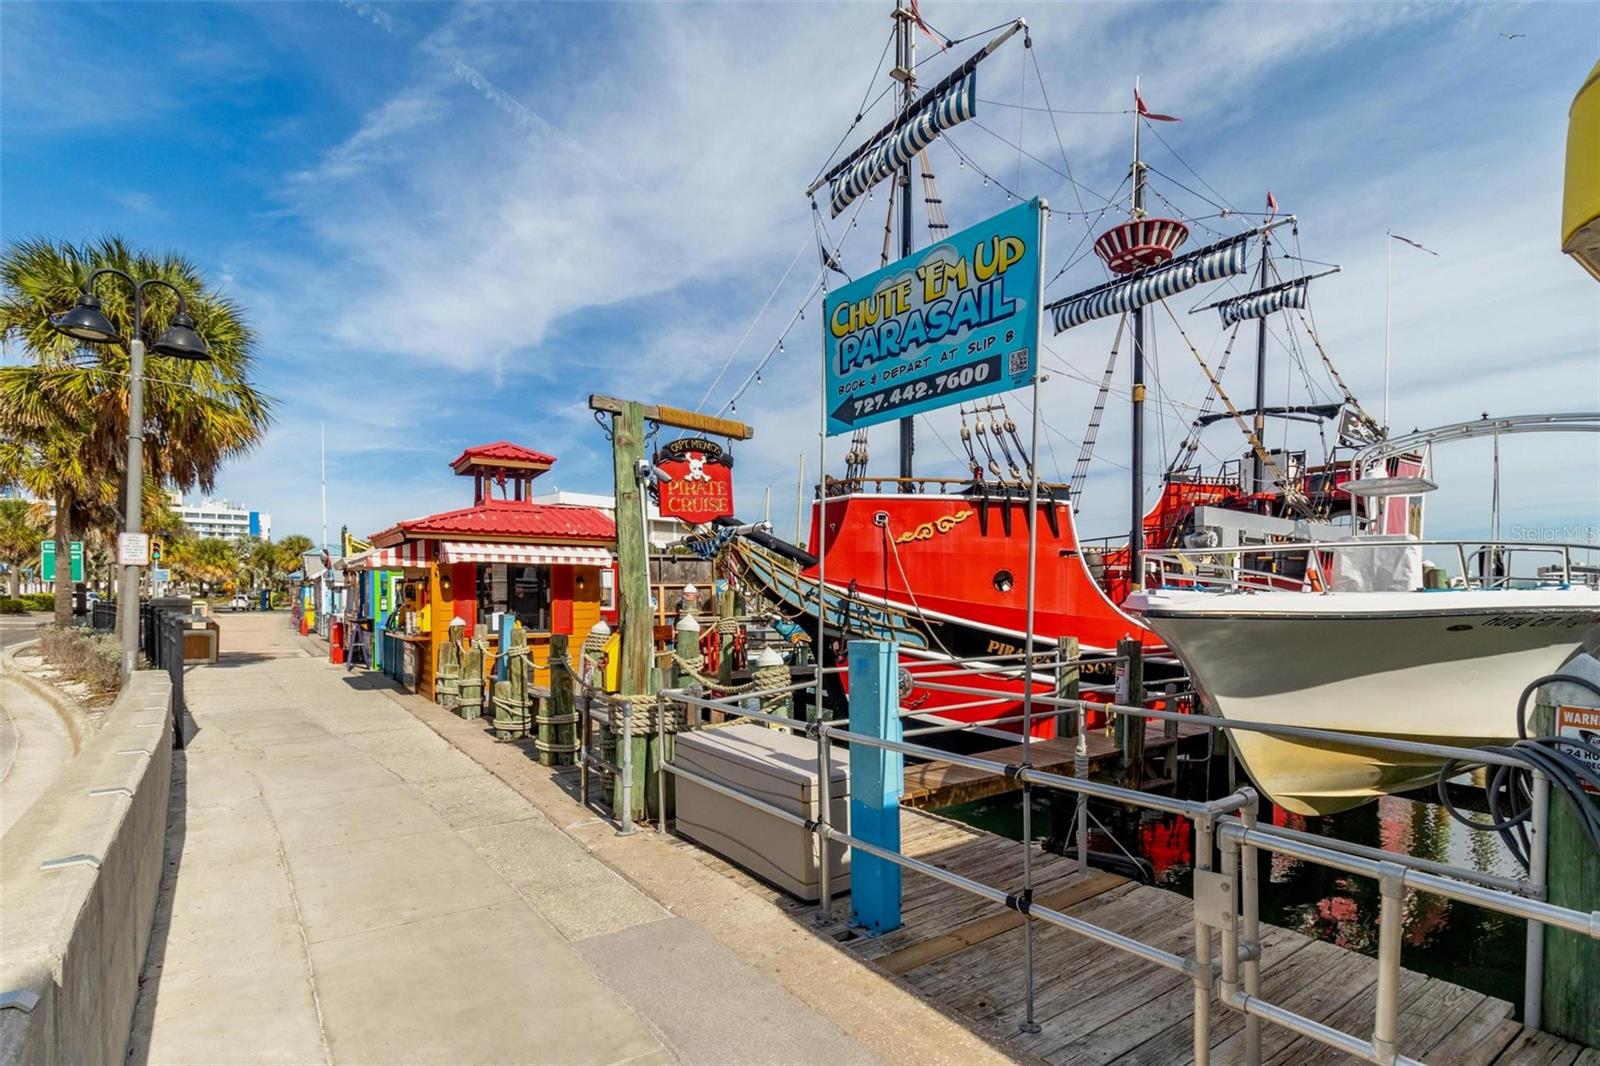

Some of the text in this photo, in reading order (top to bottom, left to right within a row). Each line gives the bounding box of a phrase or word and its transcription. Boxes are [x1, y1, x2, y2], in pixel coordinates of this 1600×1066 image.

[830, 235, 1025, 337] CHUTE 'EM UP
[839, 277, 1017, 375] PARASAIL
[838, 330, 1015, 396] BOOK & DEPART AT SLIP 8
[853, 363, 990, 417] 727.442.7600
[668, 481, 728, 496] PIRATE
[668, 497, 729, 513] CRUISE
[1563, 711, 1600, 726] WARN
